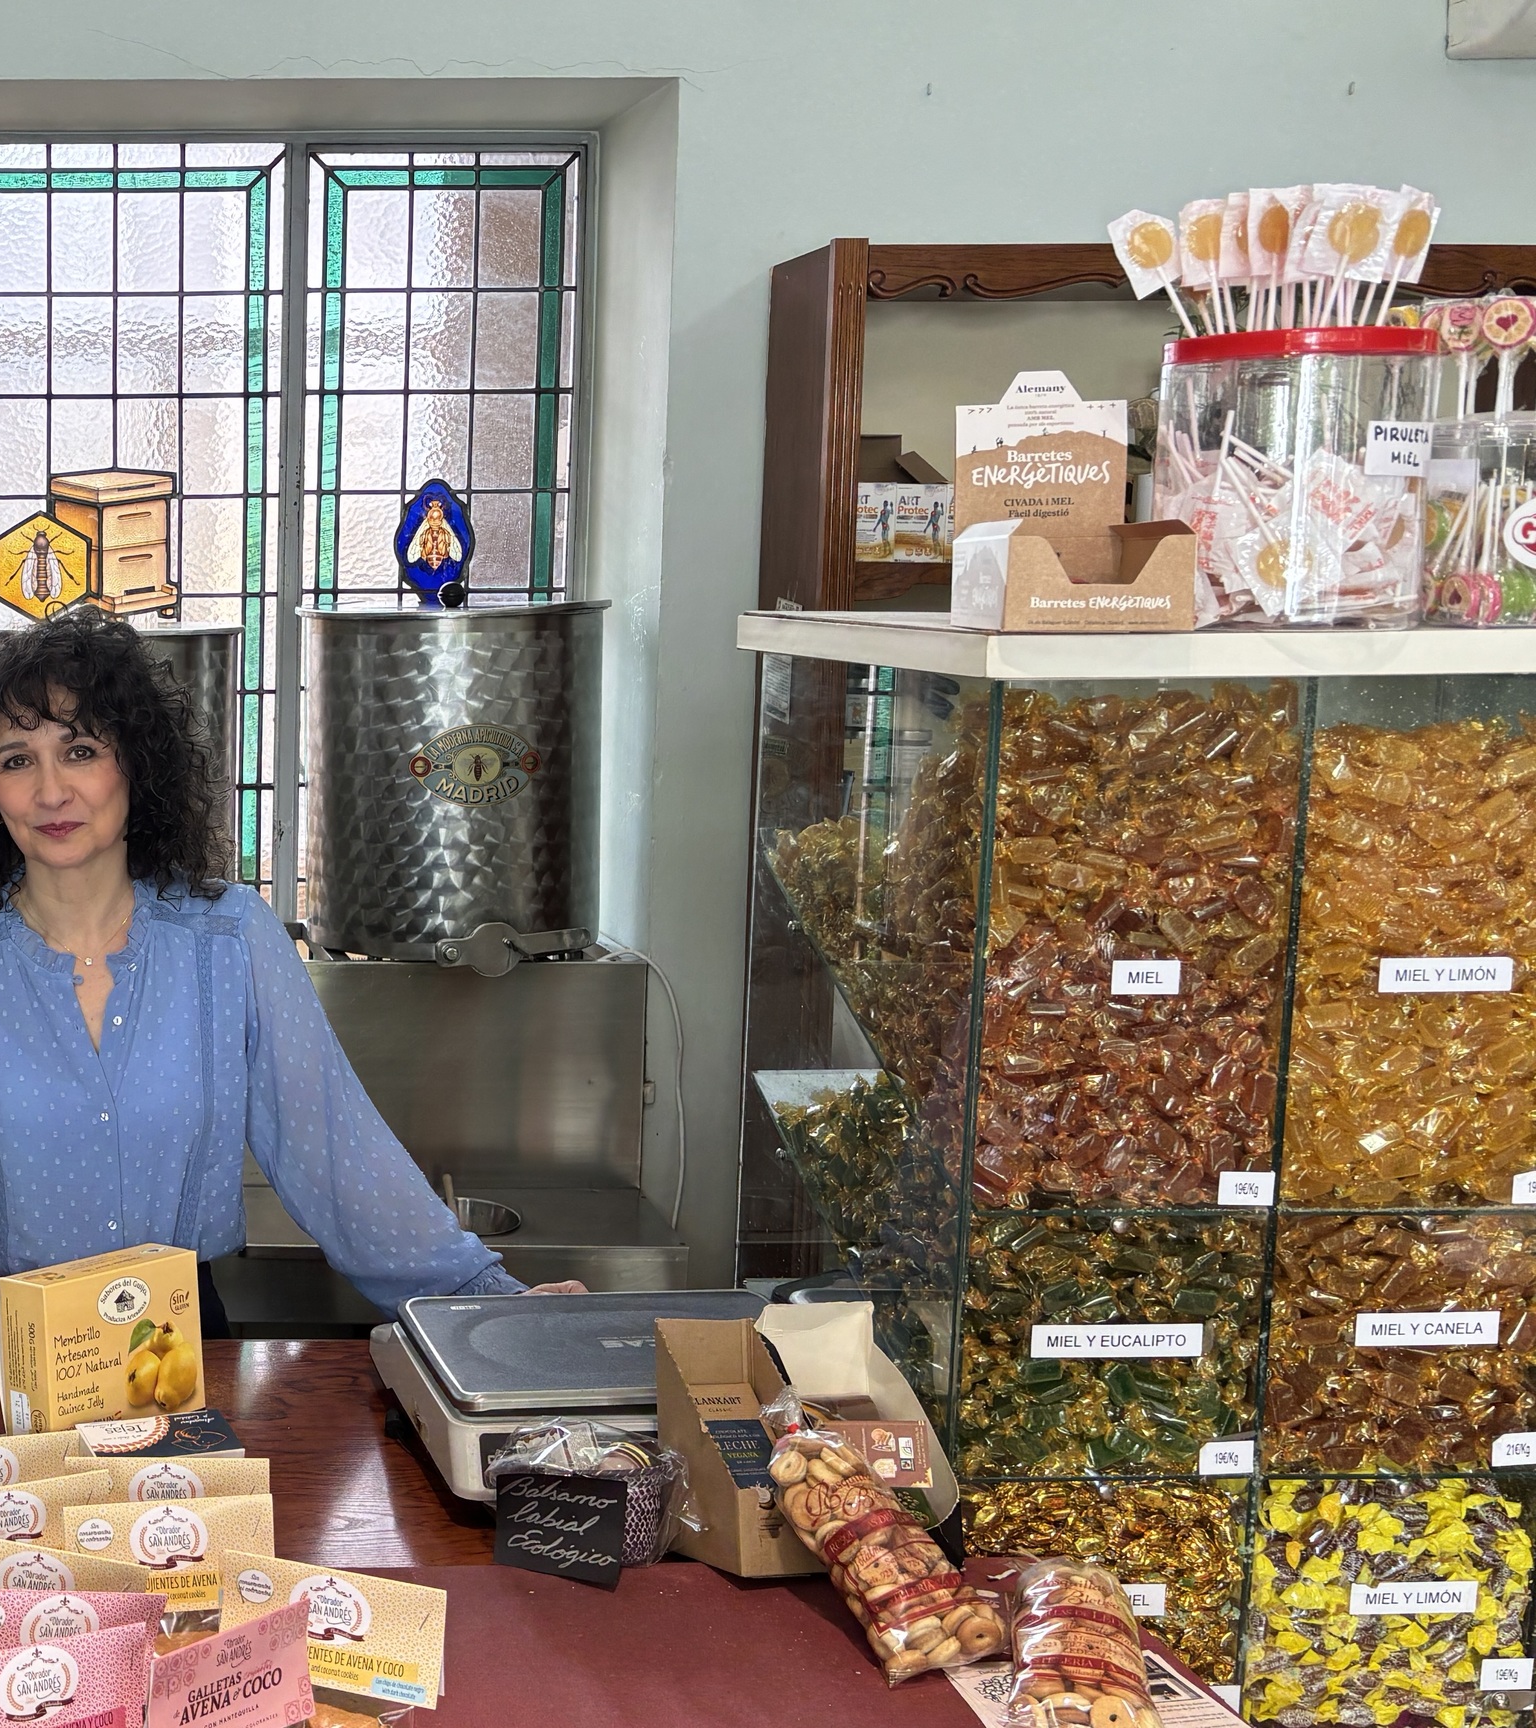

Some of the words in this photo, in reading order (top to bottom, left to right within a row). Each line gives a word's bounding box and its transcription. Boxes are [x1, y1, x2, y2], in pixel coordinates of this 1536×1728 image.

[1015, 385, 1066, 394] Alemany
[1374, 425, 1430, 444] PIRULETA
[1006, 450, 1073, 463] Barretes
[1391, 450, 1420, 467] MIEL
[897, 505, 929, 515] Protec
[1004, 498, 1043, 507] CIVADA
[1051, 497, 1074, 507] MEL
[1008, 509, 1030, 518] Fàcil
[1033, 508, 1070, 519] digestió
[1030, 596, 1086, 609] Barretes
[438, 729, 473, 751] MODERNA
[475, 728, 512, 749] APICULTURA
[435, 776, 519, 803] MADRID
[1127, 970, 1162, 985] MIEL
[1395, 968, 1430, 983] MIEL
[1433, 968, 1444, 982] Y
[1448, 965, 1496, 982] LIMÓN
[1234, 1181, 1259, 1199] 19€/Kg
[1371, 1322, 1407, 1337] MIEL
[1410, 1322, 1421, 1336] Y
[1424, 1320, 1484, 1336] CANELA
[54, 1326, 101, 1349] Membrillo
[1046, 1334, 1082, 1348] MIEL
[1085, 1334, 1096, 1347] Y
[1100, 1332, 1187, 1348] EUCALIPTO
[55, 1345, 100, 1365] Artesano
[56, 1365, 82, 1382] 100%
[86, 1352, 122, 1372] Natural
[57, 1381, 99, 1403] Handmade
[58, 1402, 85, 1416] Quince
[87, 1396, 104, 1409] Jelly
[695, 1397, 742, 1405] LANXART
[105, 1424, 147, 1435] Tejas
[720, 1440, 760, 1450] LECHE
[1506, 1442, 1531, 1459] 21€/Kg
[1214, 1451, 1239, 1467] 19€/Kg
[146, 1576, 179, 1590] UJIENTES
[181, 1576, 190, 1587] DE
[192, 1574, 217, 1587] AVENA
[1366, 1591, 1401, 1606] MIEL
[1403, 1591, 1413, 1605] Y
[1417, 1588, 1462, 1605] LIMÓN
[308, 1601, 323, 1615] SAN
[324, 1606, 352, 1625] ANDRÉS
[311, 1664, 321, 1673] and
[321, 1666, 341, 1678] coconut
[341, 1670, 359, 1680] cookies
[335, 1650, 345, 1666] DE
[346, 1654, 374, 1671] AVENA
[376, 1660, 382, 1672] Y
[383, 1661, 404, 1677] COCO
[1495, 1667, 1519, 1684] 19€/Kg
[17, 1681, 32, 1696] SAN
[33, 1675, 62, 1699] ANDRÉS
[188, 1671, 242, 1703] GALLETAS
[179, 1690, 230, 1726] AVENA
[243, 1667, 282, 1699] COCO
[218, 1704, 259, 1725] MANTEQUILLA
